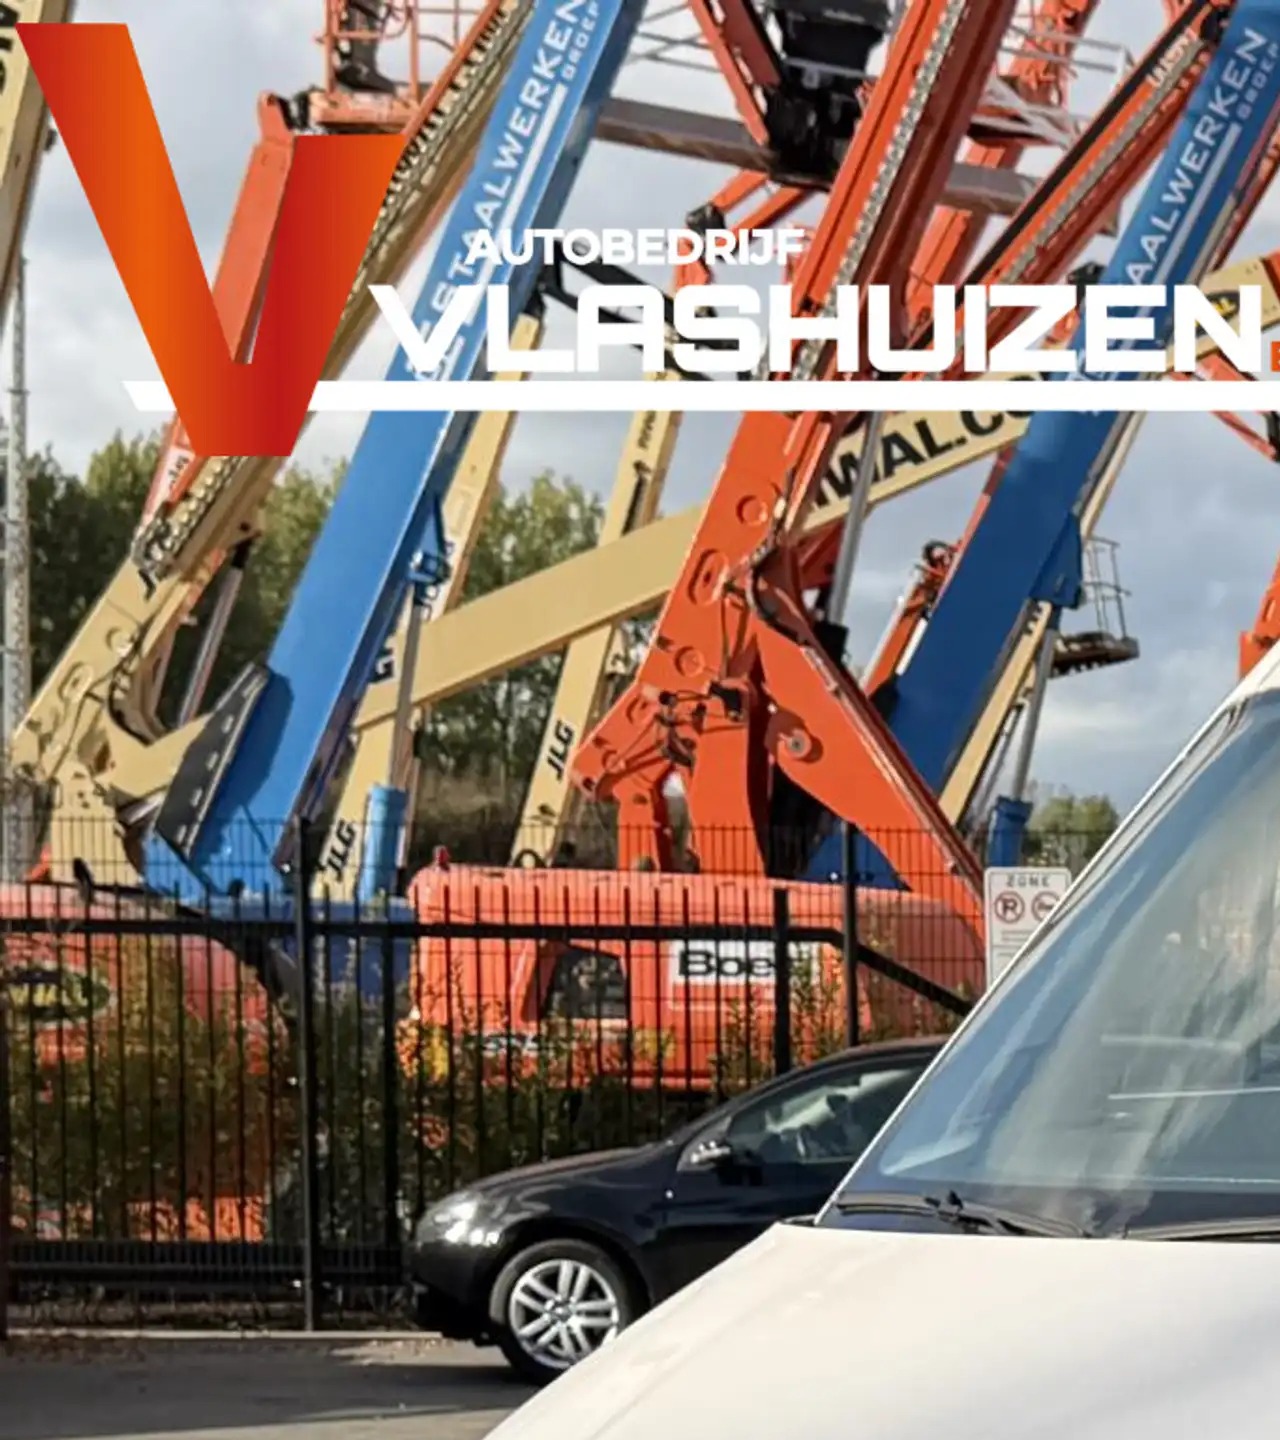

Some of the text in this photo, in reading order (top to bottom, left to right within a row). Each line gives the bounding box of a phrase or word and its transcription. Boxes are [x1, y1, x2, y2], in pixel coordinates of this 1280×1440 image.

[1126, 27, 1268, 285] AALWERKEN
[547, 720, 574, 781] JLG
[327, 819, 356, 883] JLG
[679, 950, 778, 977] Boe
